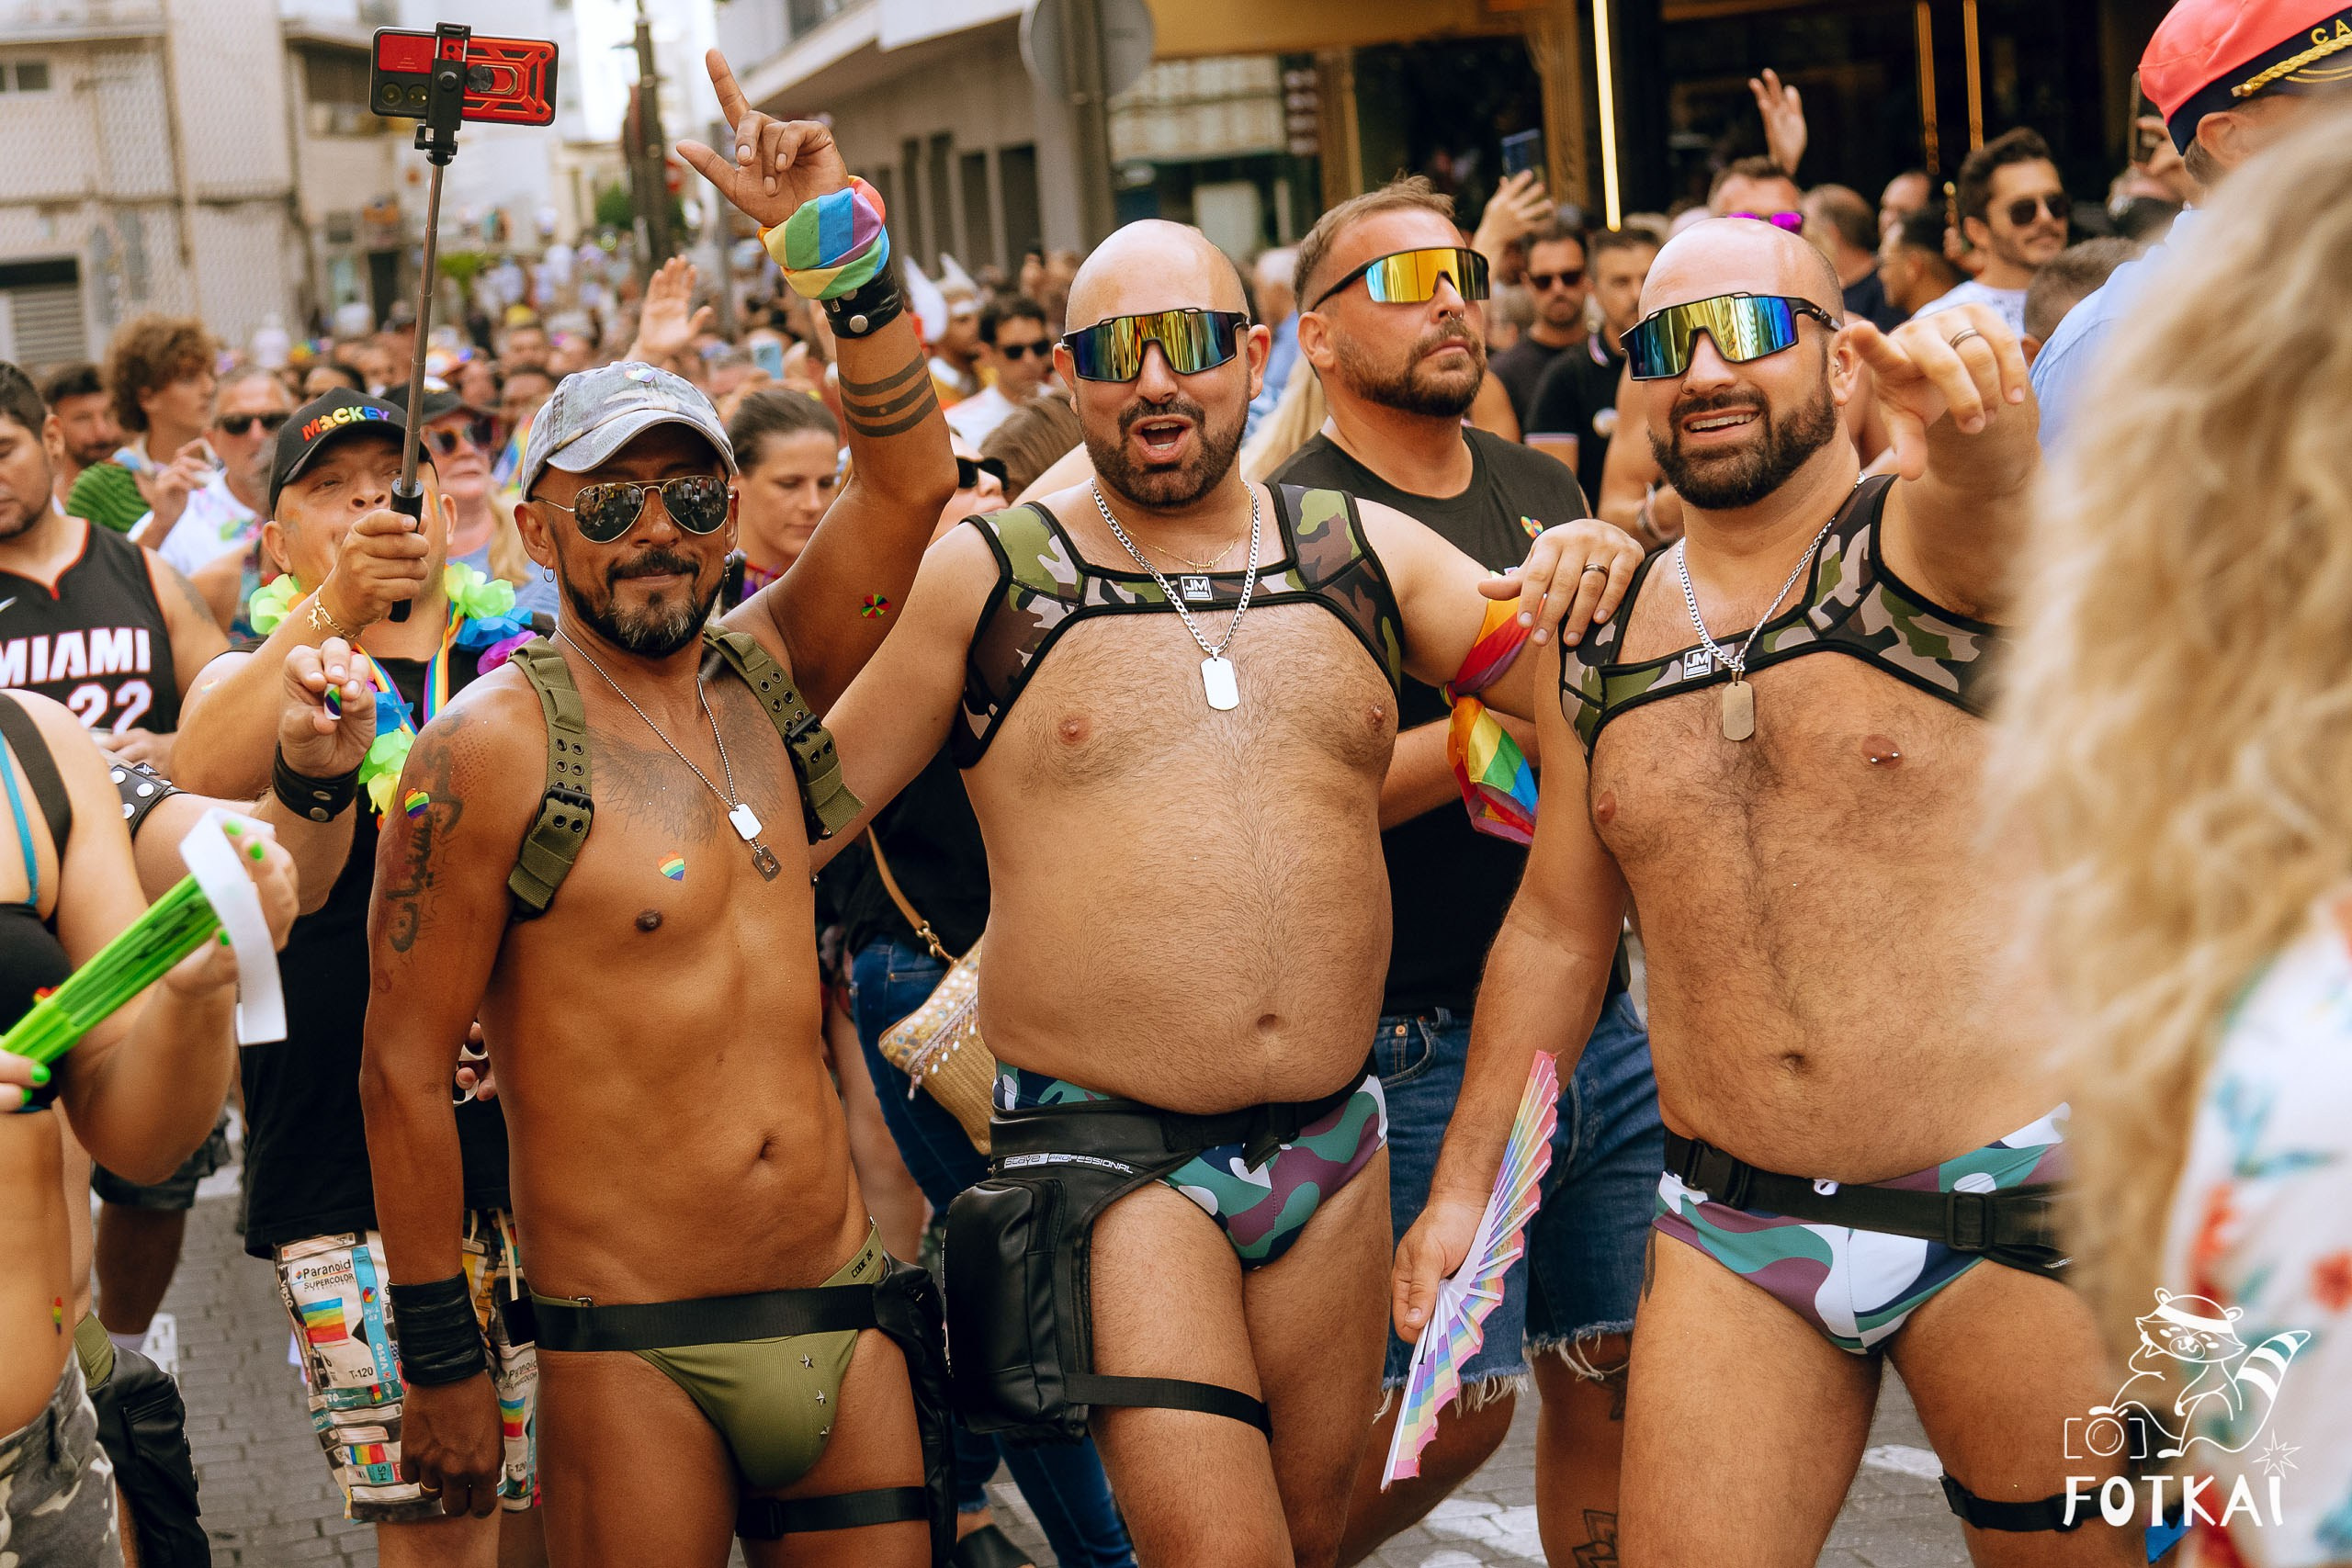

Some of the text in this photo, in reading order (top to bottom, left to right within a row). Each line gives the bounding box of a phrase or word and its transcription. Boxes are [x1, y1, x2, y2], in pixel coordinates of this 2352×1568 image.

[1185, 579, 1208, 592] JM
[0, 626, 152, 689] MIAMI
[1687, 650, 1710, 668] JM
[67, 678, 153, 736] 22
[1048, 1154, 1134, 1174] PROFESSIONAL
[303, 1259, 352, 1279] Paranoid
[304, 1273, 355, 1289] SUPERCOLOR
[349, 1367, 374, 1380] T-120
